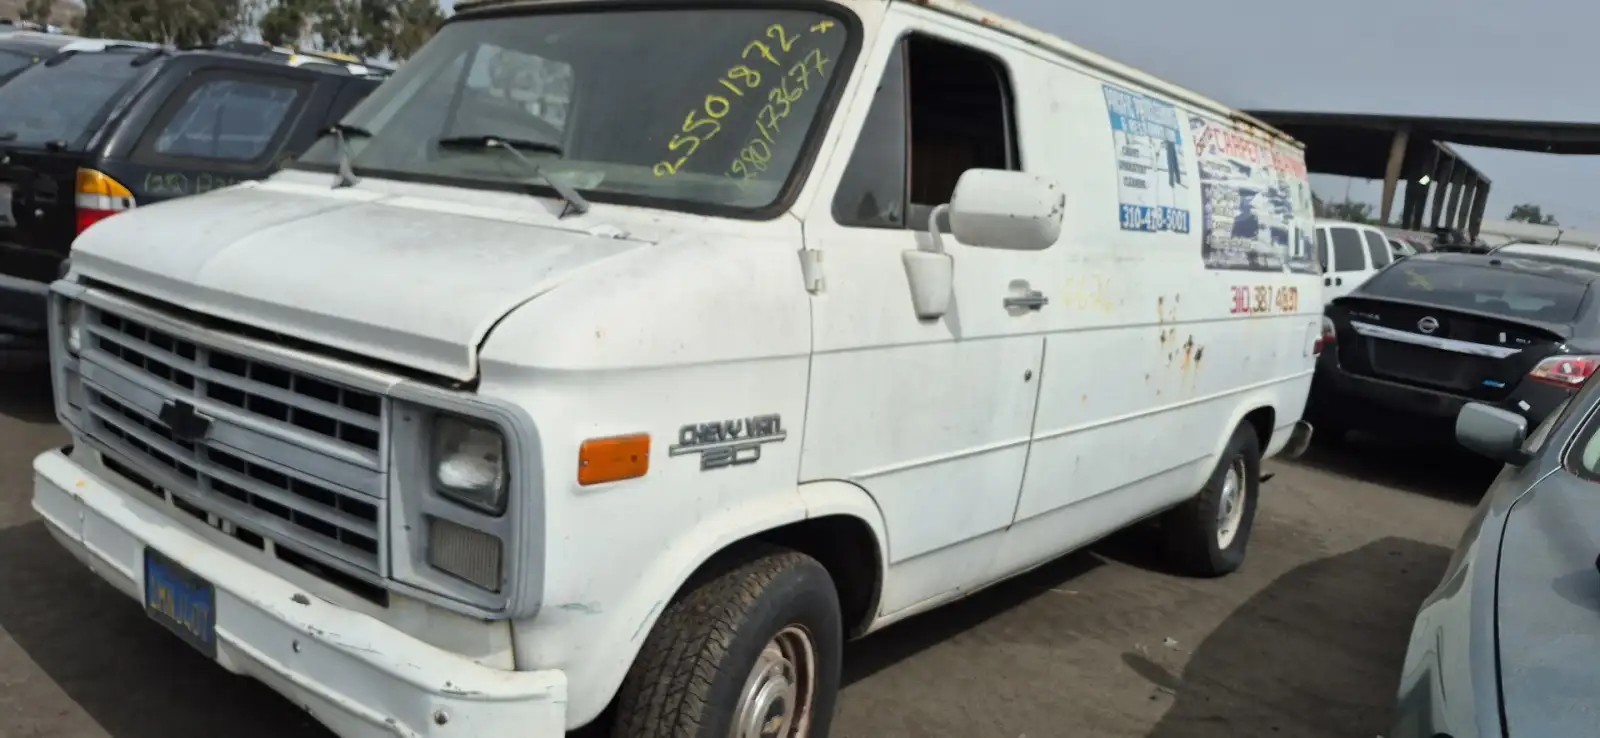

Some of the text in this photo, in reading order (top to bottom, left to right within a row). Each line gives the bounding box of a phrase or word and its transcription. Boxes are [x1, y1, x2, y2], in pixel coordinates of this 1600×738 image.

[653, 23, 801, 177] 25501872
[679, 413, 781, 446] CHEVY VAN
[700, 442, 761, 472] 20
